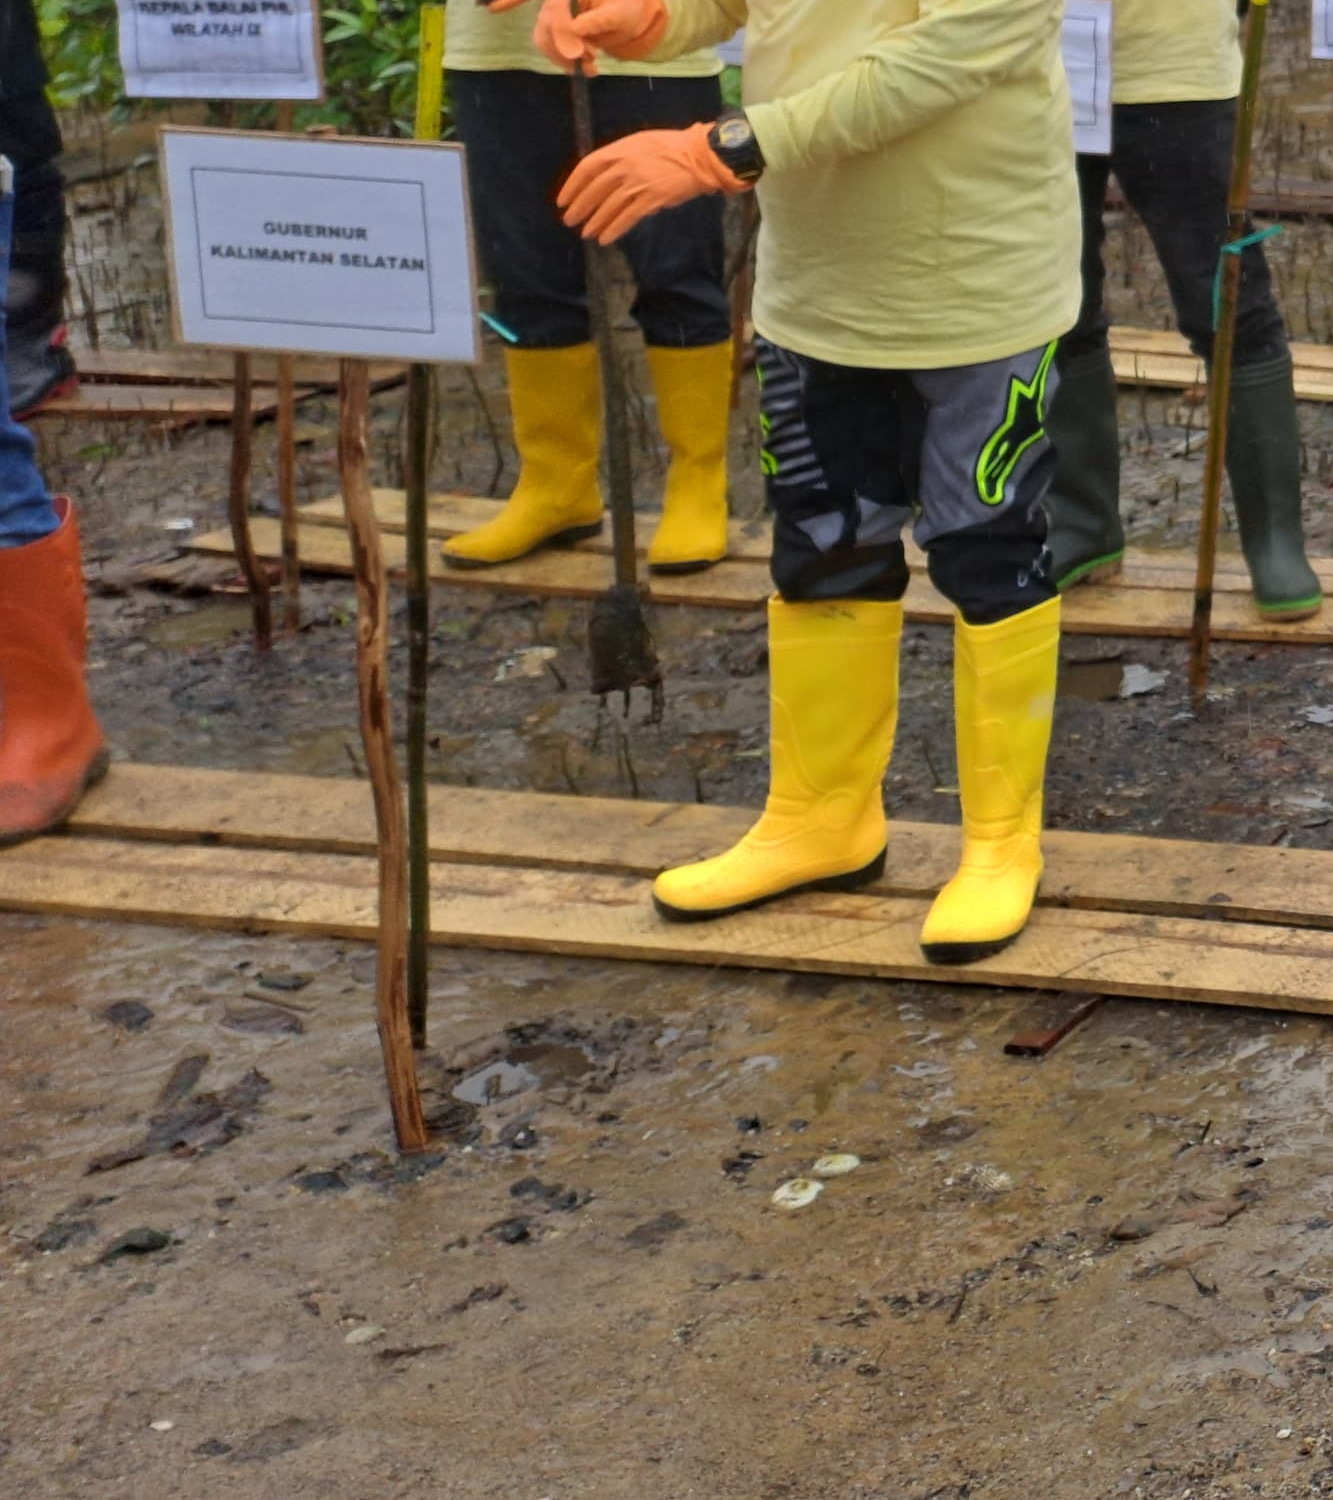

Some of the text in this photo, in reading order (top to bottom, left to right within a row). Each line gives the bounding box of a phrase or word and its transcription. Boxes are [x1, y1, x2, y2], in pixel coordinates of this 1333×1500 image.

[263, 221, 368, 241] GUBERNUR
[210, 245, 426, 271] KALIMANTAN SELATAN
